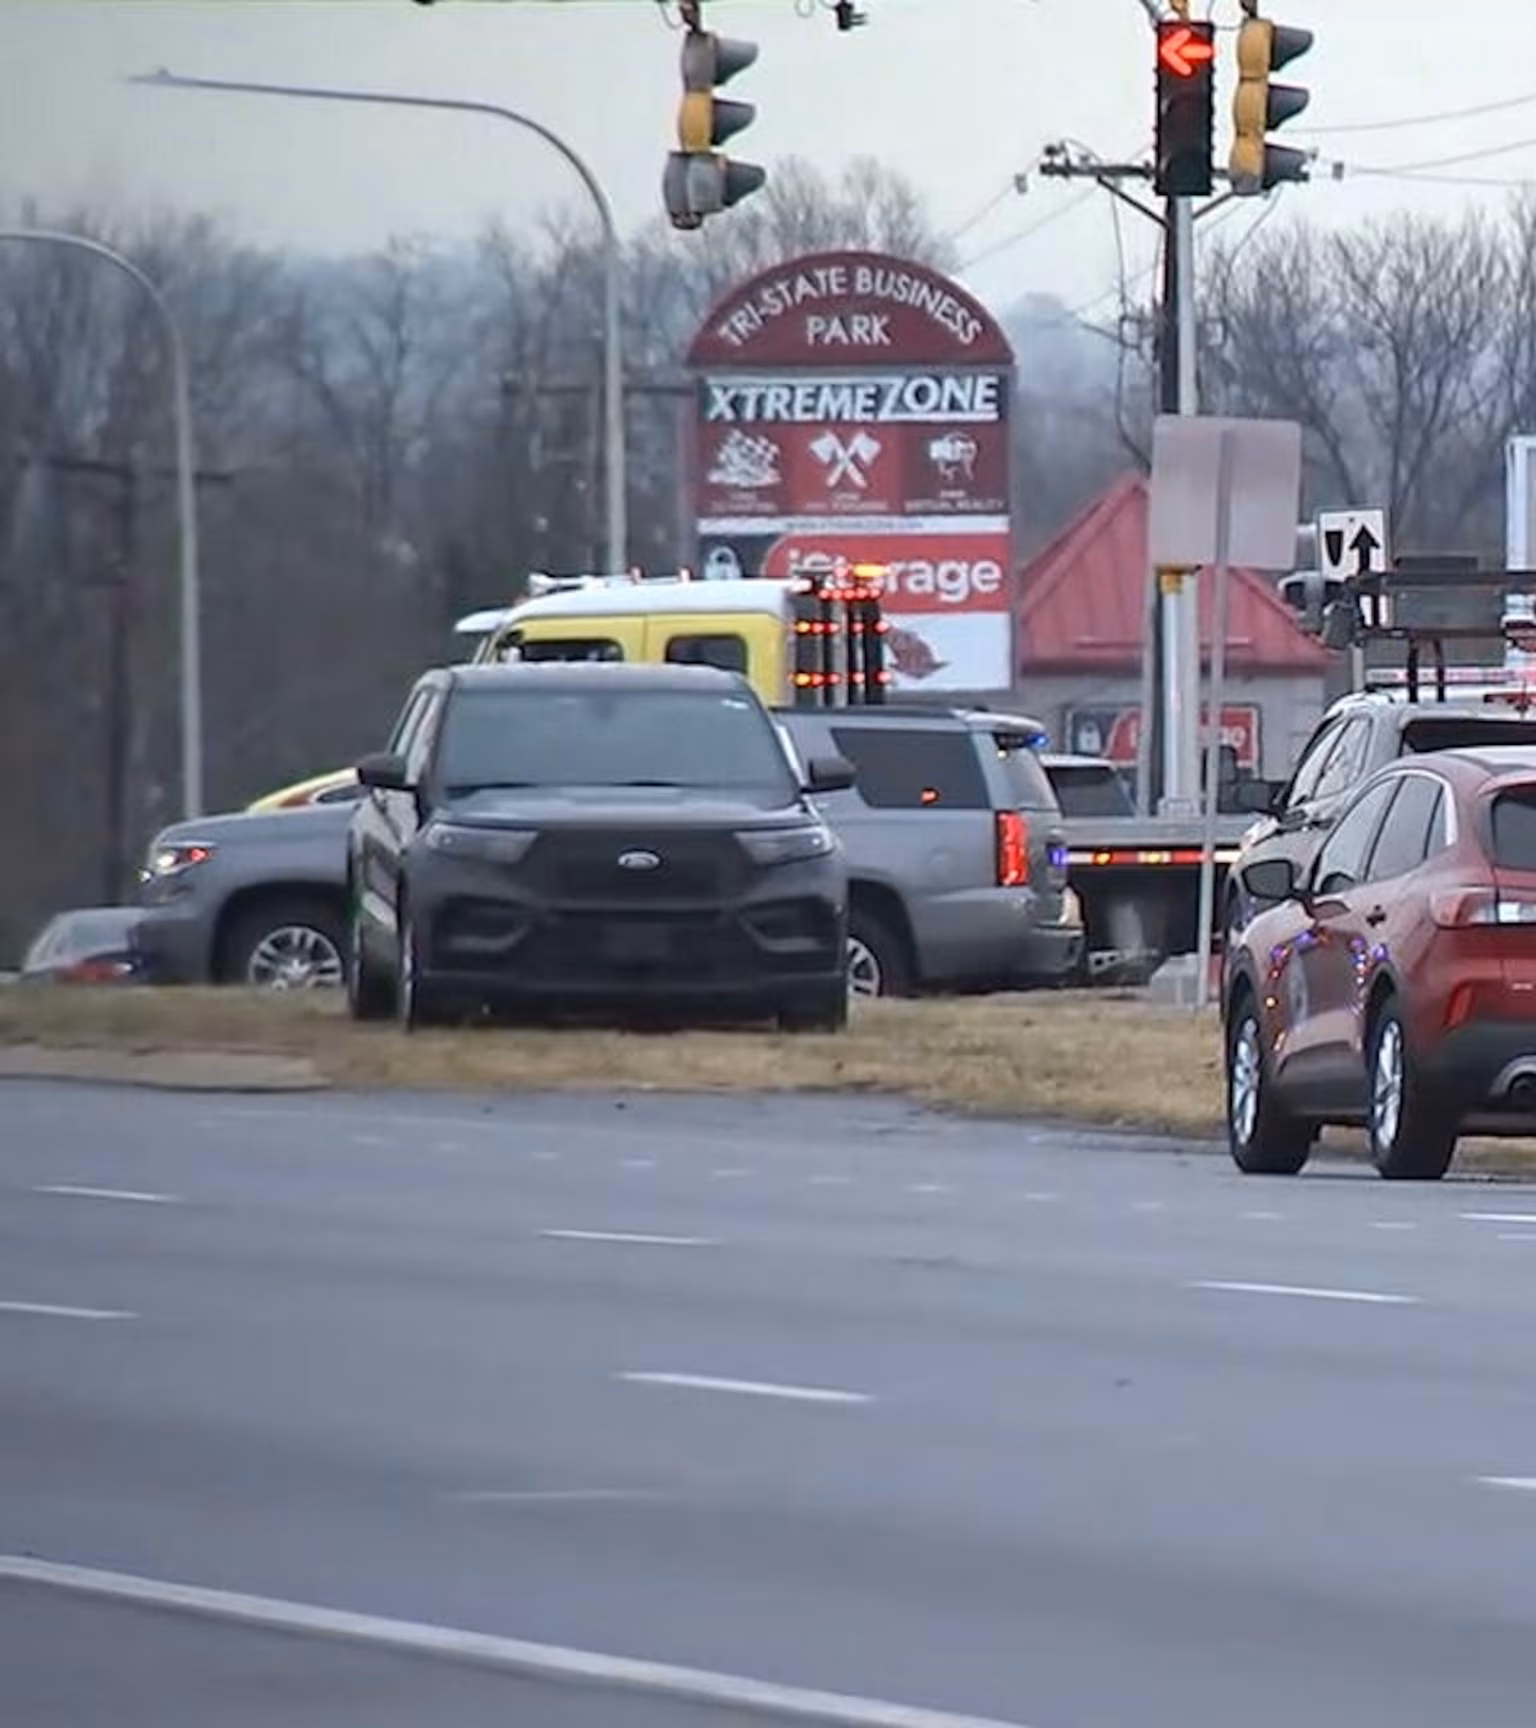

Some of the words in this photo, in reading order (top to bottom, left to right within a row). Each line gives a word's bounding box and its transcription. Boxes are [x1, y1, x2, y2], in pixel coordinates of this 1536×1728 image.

[718, 267, 847, 348] TRI-STATE
[856, 267, 983, 346] BUSINESS
[807, 314, 891, 346] PARK
